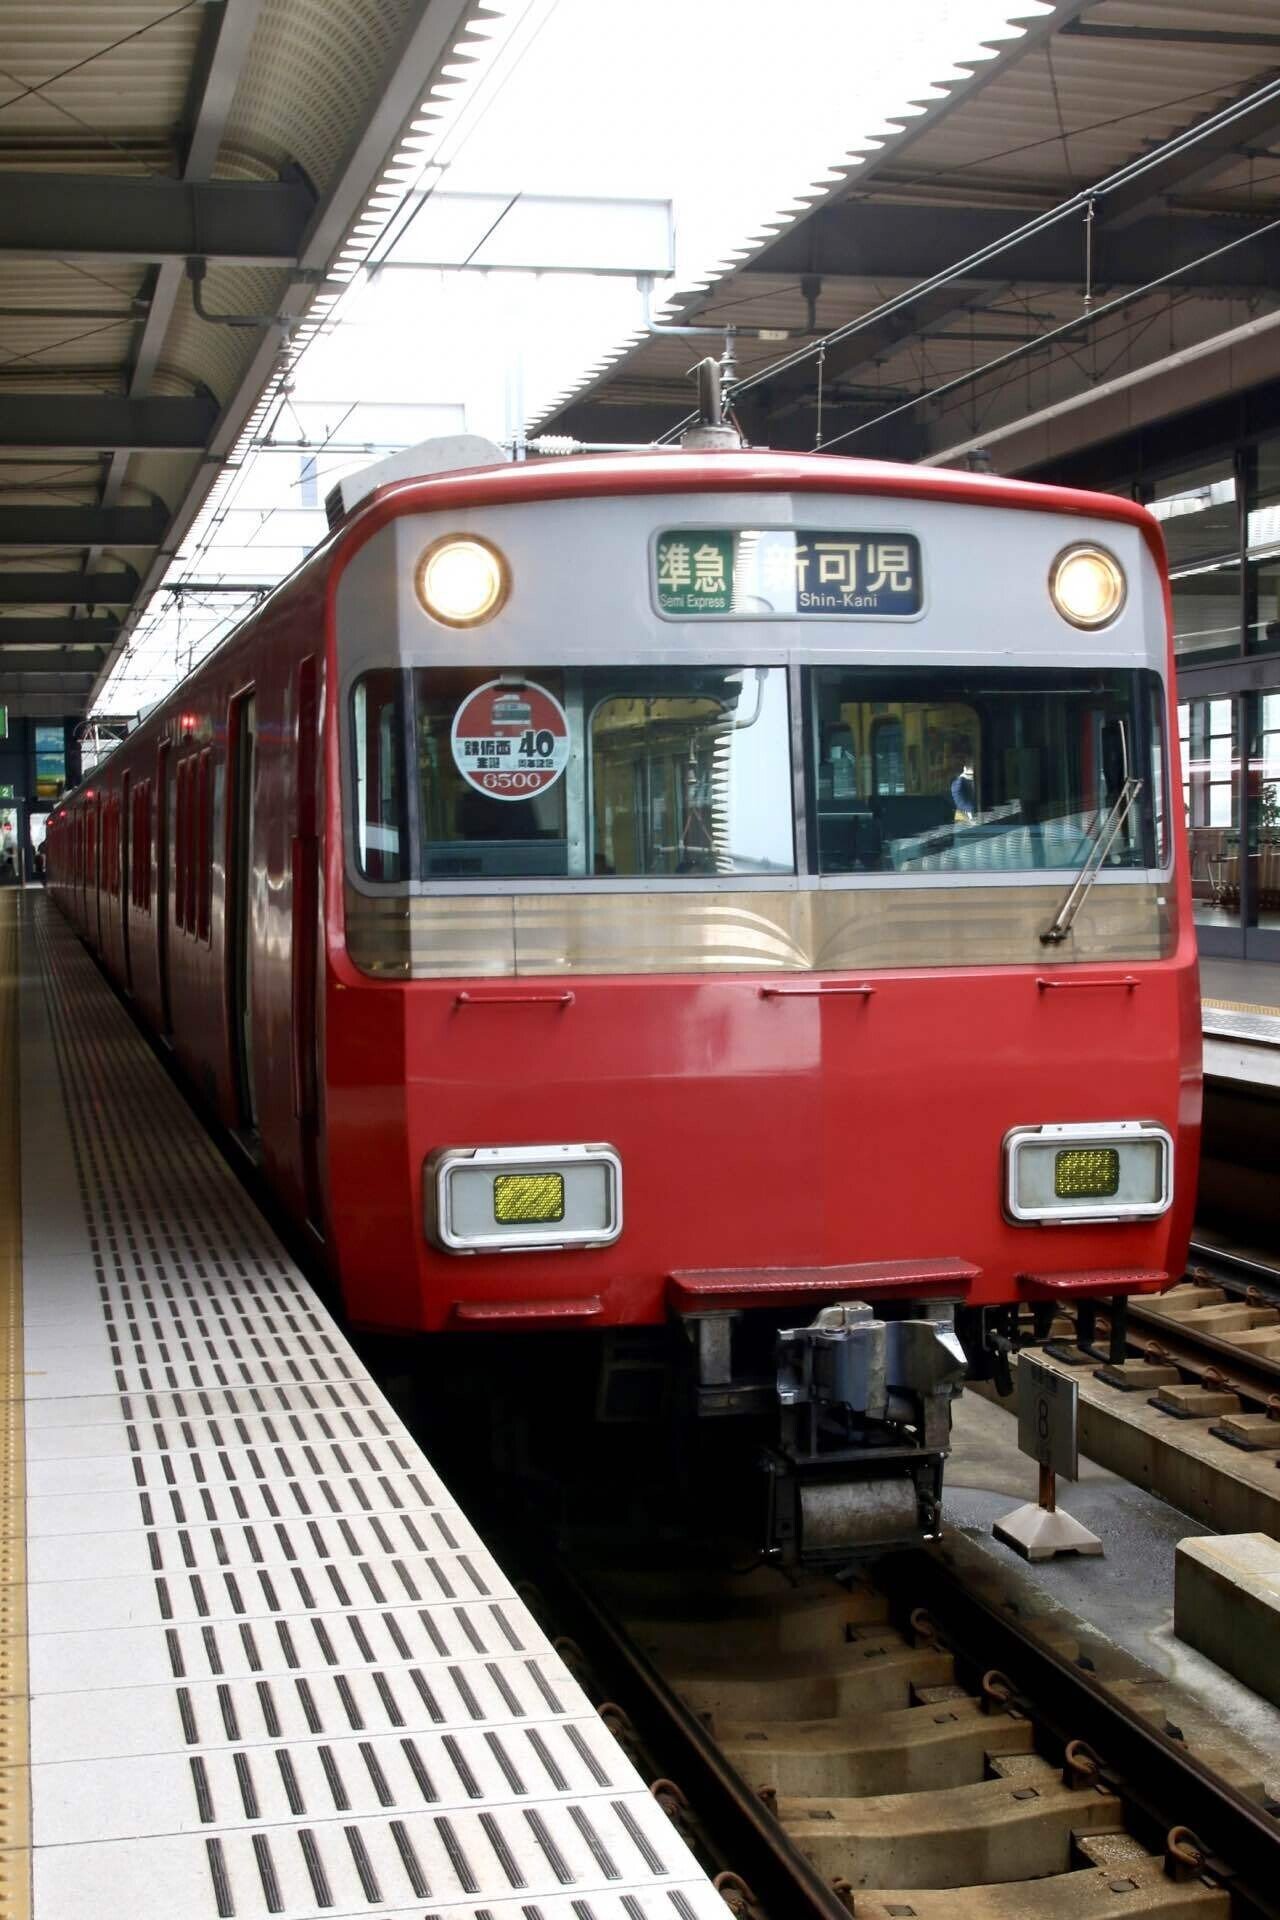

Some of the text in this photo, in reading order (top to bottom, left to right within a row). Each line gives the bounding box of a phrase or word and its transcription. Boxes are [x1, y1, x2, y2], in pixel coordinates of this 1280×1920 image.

[659, 543, 726, 592] 準急
[660, 594, 726, 610] Semi Express
[800, 592, 878, 607] Shin-Kani
[519, 731, 554, 757] 40
[483, 773, 541, 788] 6500
[1038, 1398, 1049, 1440] 8
